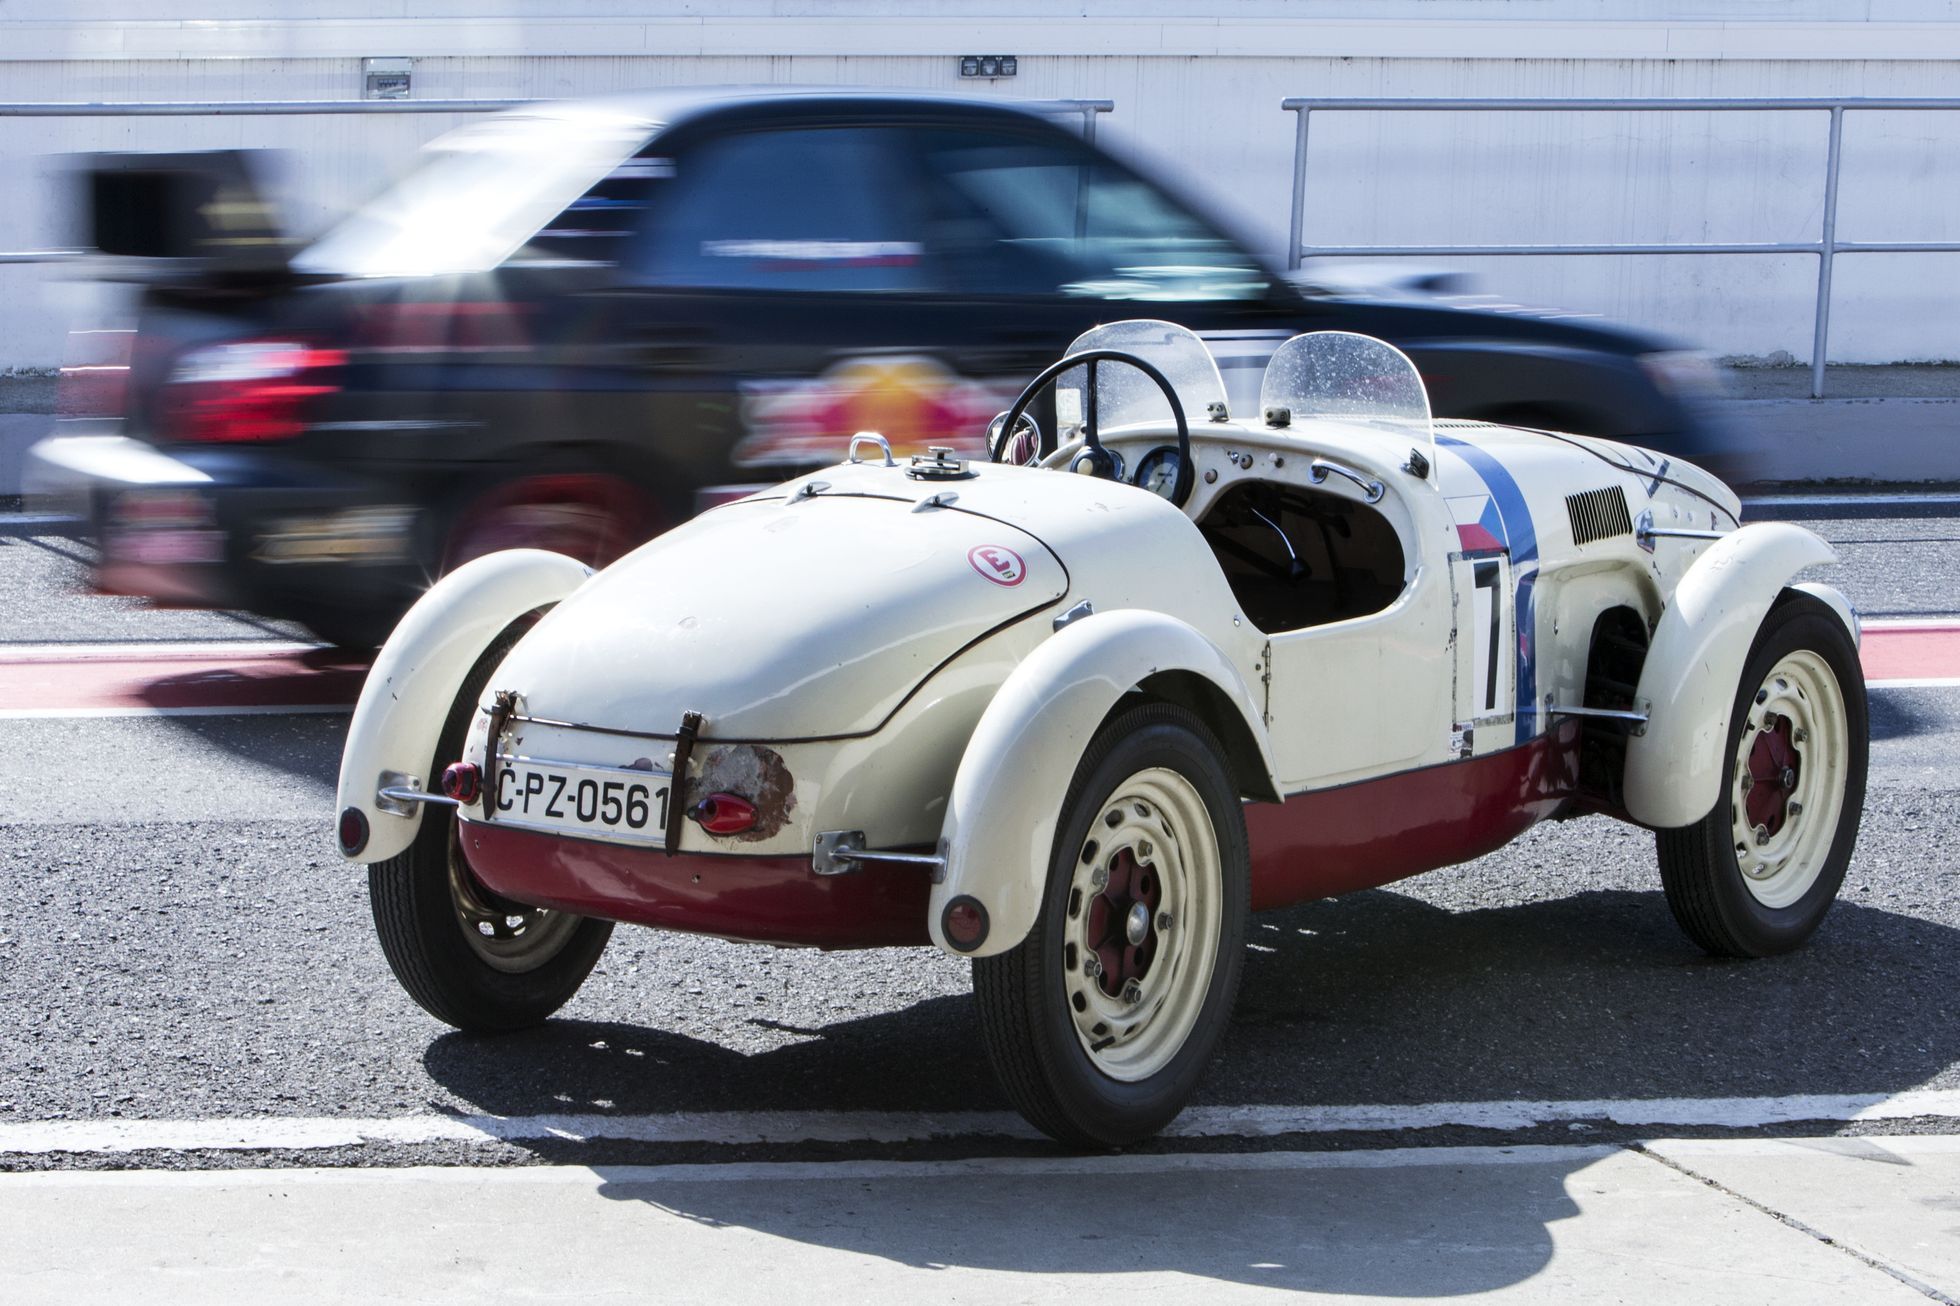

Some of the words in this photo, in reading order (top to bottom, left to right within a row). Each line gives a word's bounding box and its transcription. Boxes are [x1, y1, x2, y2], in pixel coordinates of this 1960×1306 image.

[978, 549, 1011, 573] E
[1473, 561, 1501, 710] 7
[497, 761, 669, 830] Č-PZ-0561
